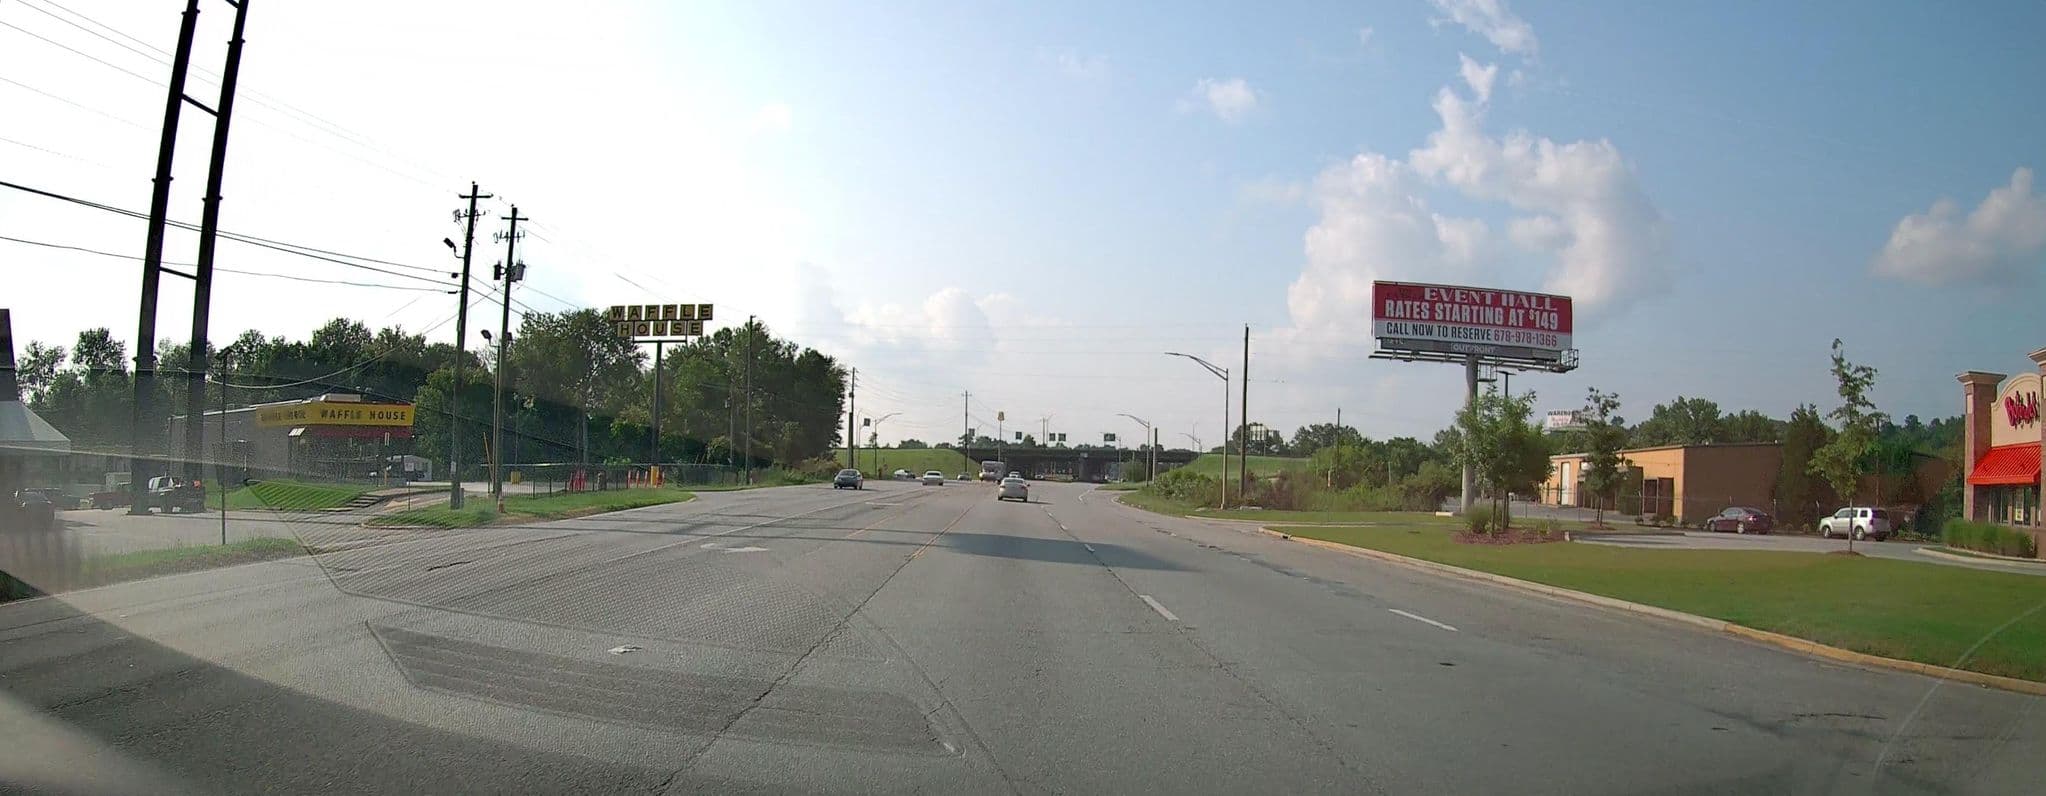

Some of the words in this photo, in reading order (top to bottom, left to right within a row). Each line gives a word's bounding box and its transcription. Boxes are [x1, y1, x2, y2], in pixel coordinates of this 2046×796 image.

[1424, 287, 1495, 304] EVENT
[1501, 293, 1558, 311] HALL
[611, 305, 711, 319] WAFFLE
[1385, 299, 1430, 320] RATES
[1435, 302, 1504, 325] STARTING
[1508, 308, 1525, 327] AT
[1529, 308, 1558, 331] $149
[620, 322, 701, 335] HOUSE
[1386, 321, 1409, 336] CALL
[1412, 323, 1434, 337] NOW
[1437, 325, 1448, 338] TO
[1451, 326, 1491, 341] RESERVE
[320, 409, 362, 420] WAFFLE
[369, 410, 406, 421] HOUSE
